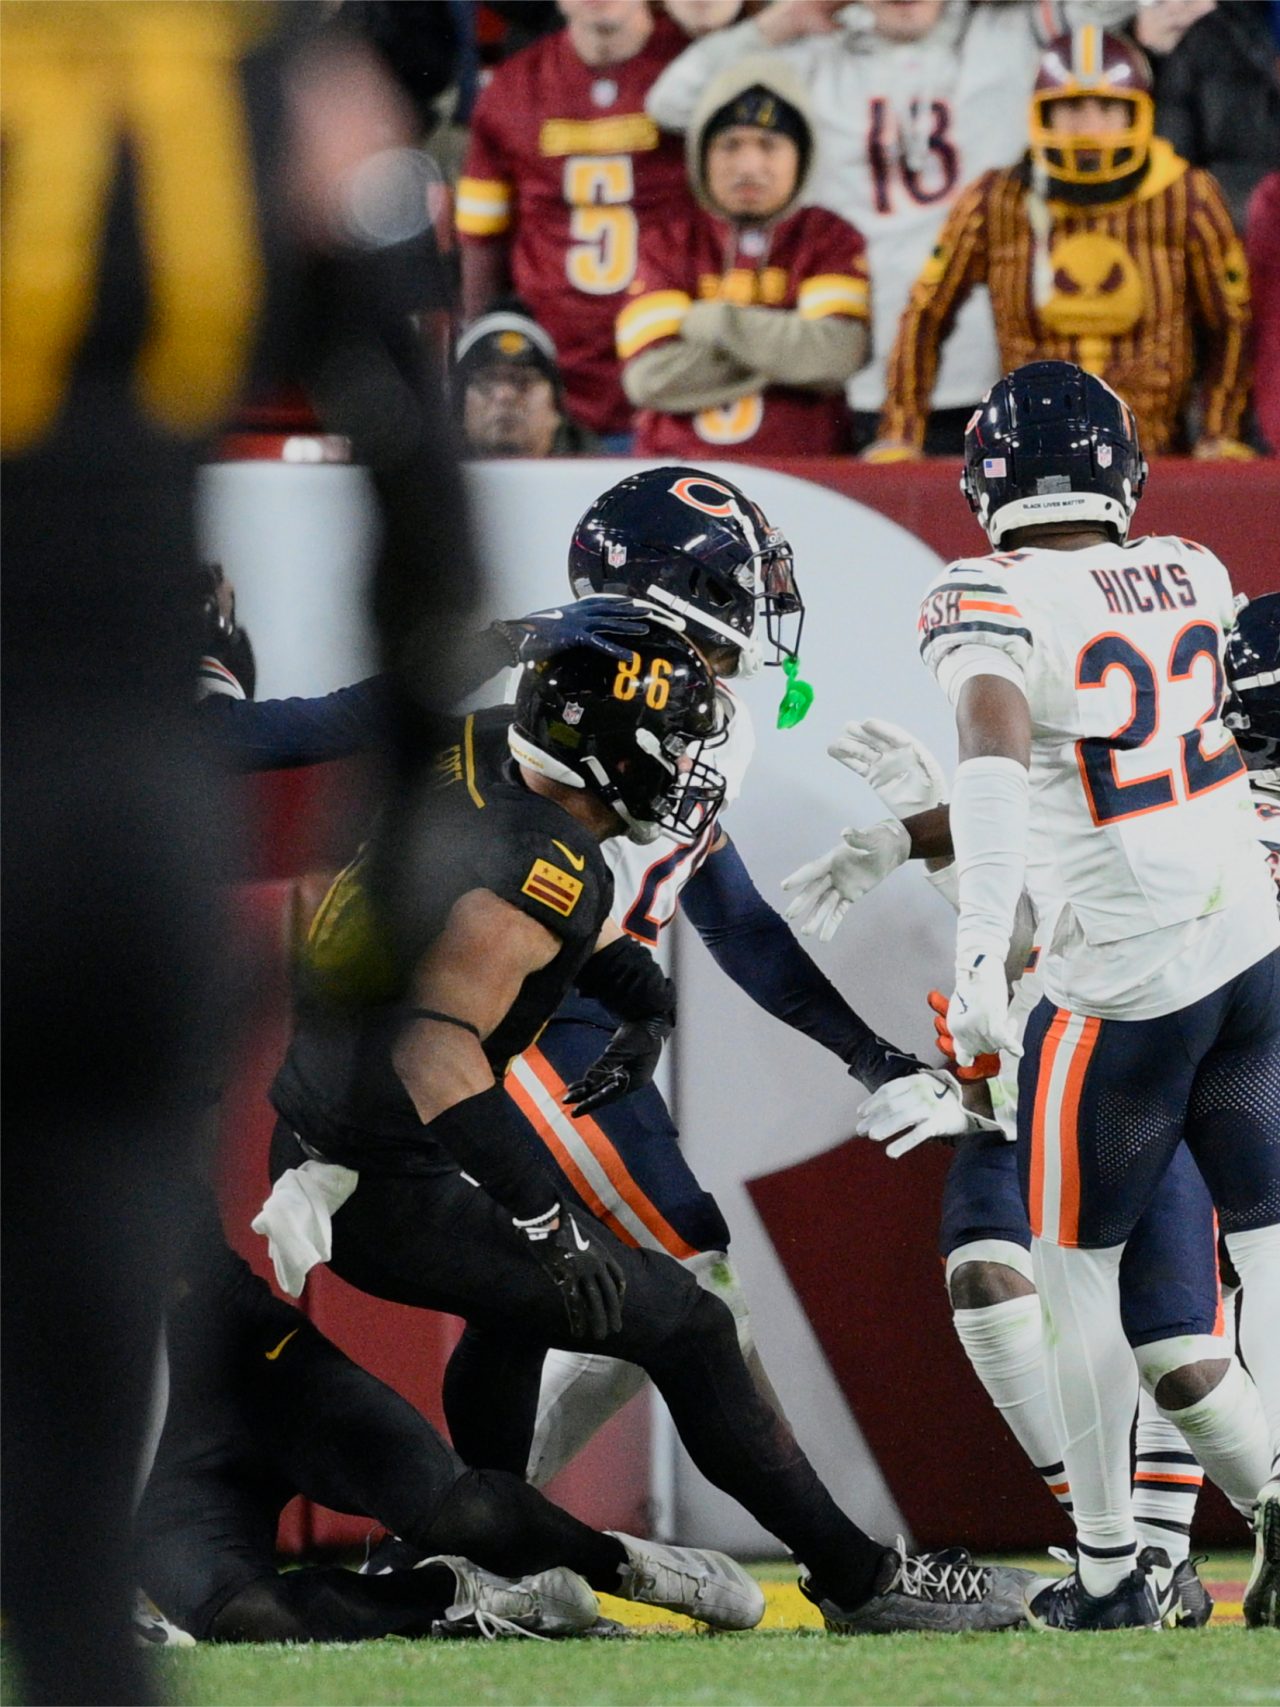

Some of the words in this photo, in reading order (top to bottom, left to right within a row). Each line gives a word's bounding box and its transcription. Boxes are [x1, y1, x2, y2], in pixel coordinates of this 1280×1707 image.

[562, 155, 639, 296] 5
[1043, 501, 1061, 509] LIVES
[1062, 499, 1085, 507] MATTER
[1090, 562, 1197, 616] HICKS
[612, 651, 674, 711] 86
[1074, 618, 1248, 829] 22
